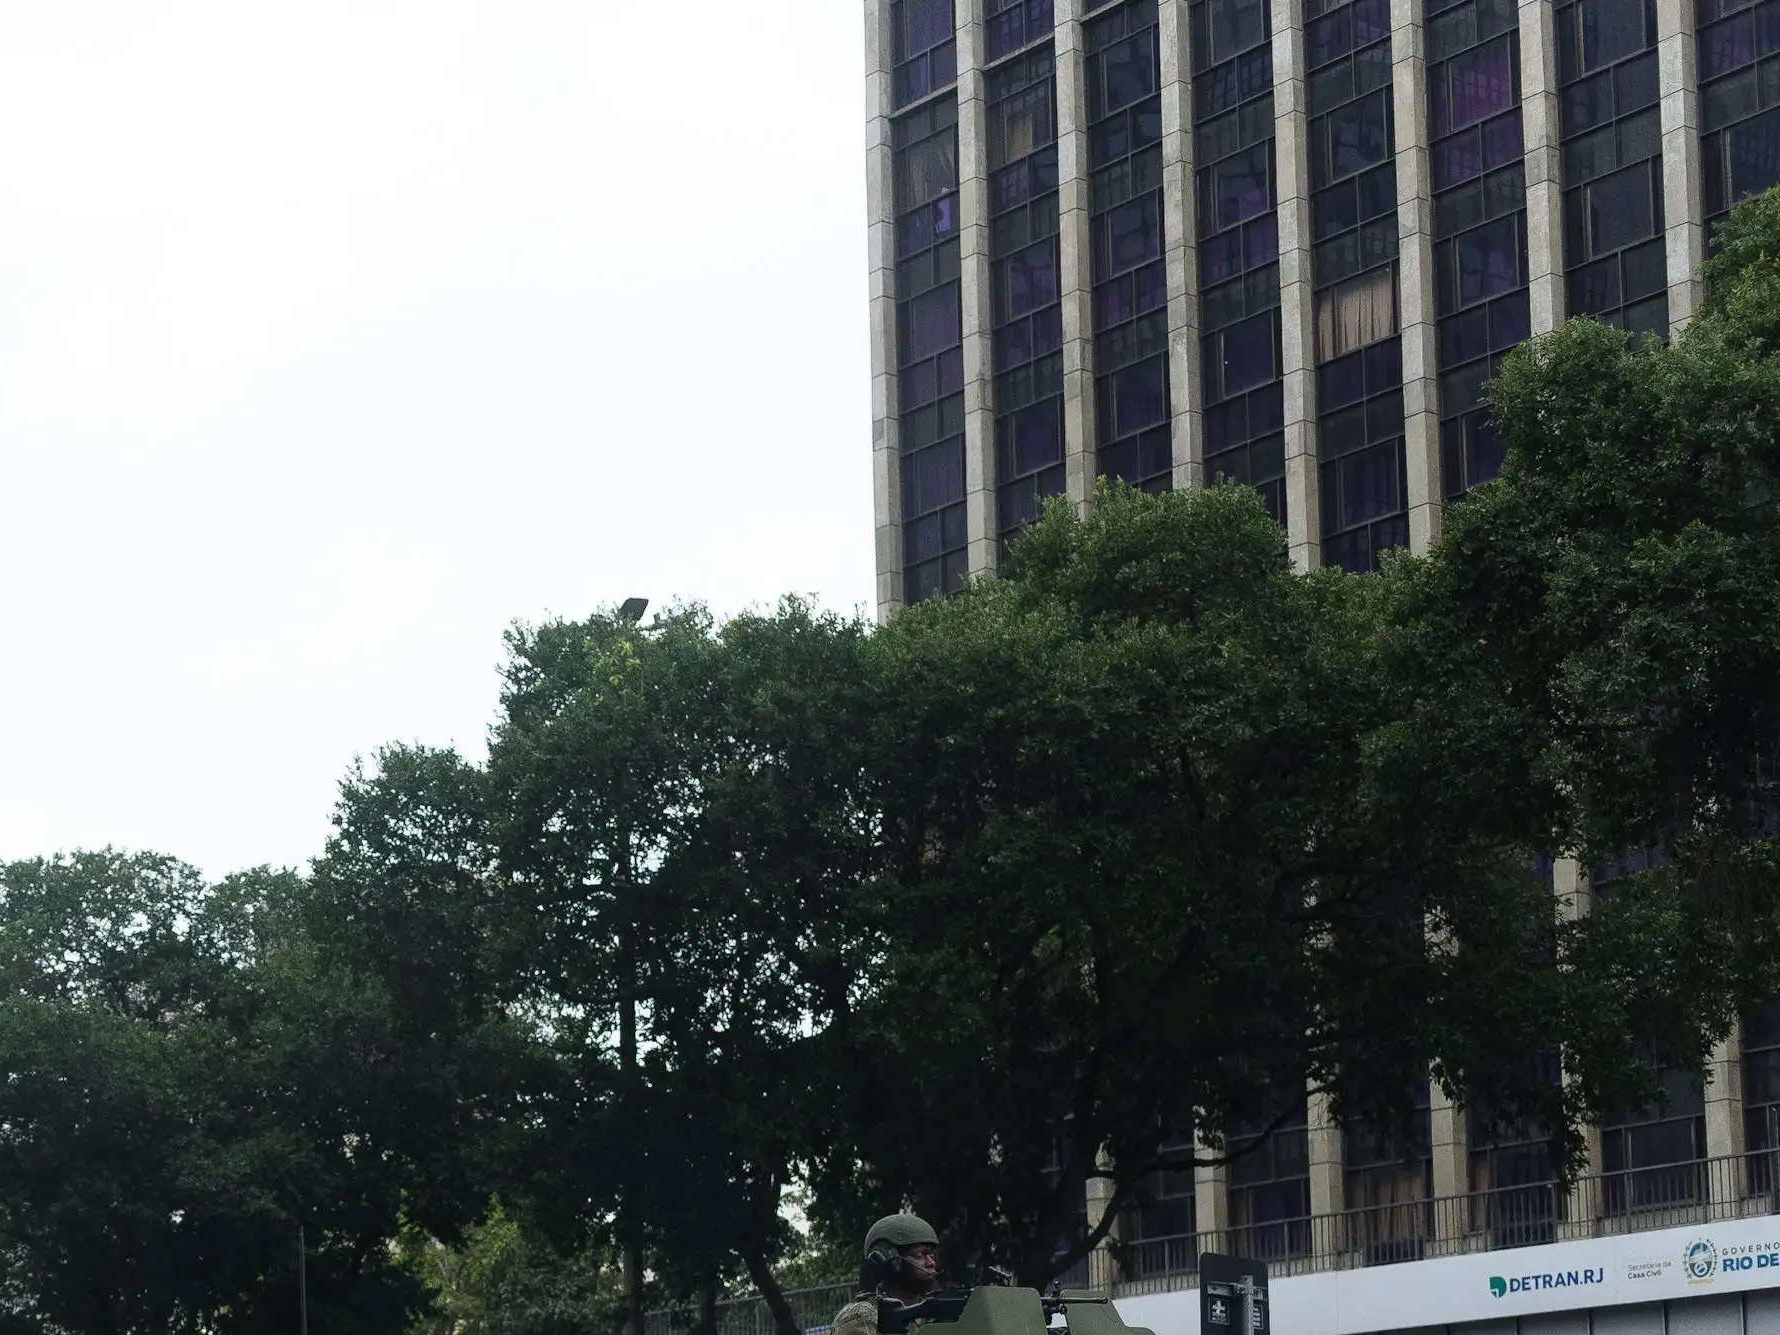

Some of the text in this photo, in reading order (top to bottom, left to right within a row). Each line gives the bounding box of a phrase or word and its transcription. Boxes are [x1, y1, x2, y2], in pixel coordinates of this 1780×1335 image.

[1722, 1241, 1780, 1256] GOVERNO
[1662, 1260, 1672, 1268] da
[1723, 1253, 1780, 1272] RIO DE
[1509, 1268, 1604, 1293] DETRAN.RJ
[1627, 1269, 1662, 1280] Casa Civil
